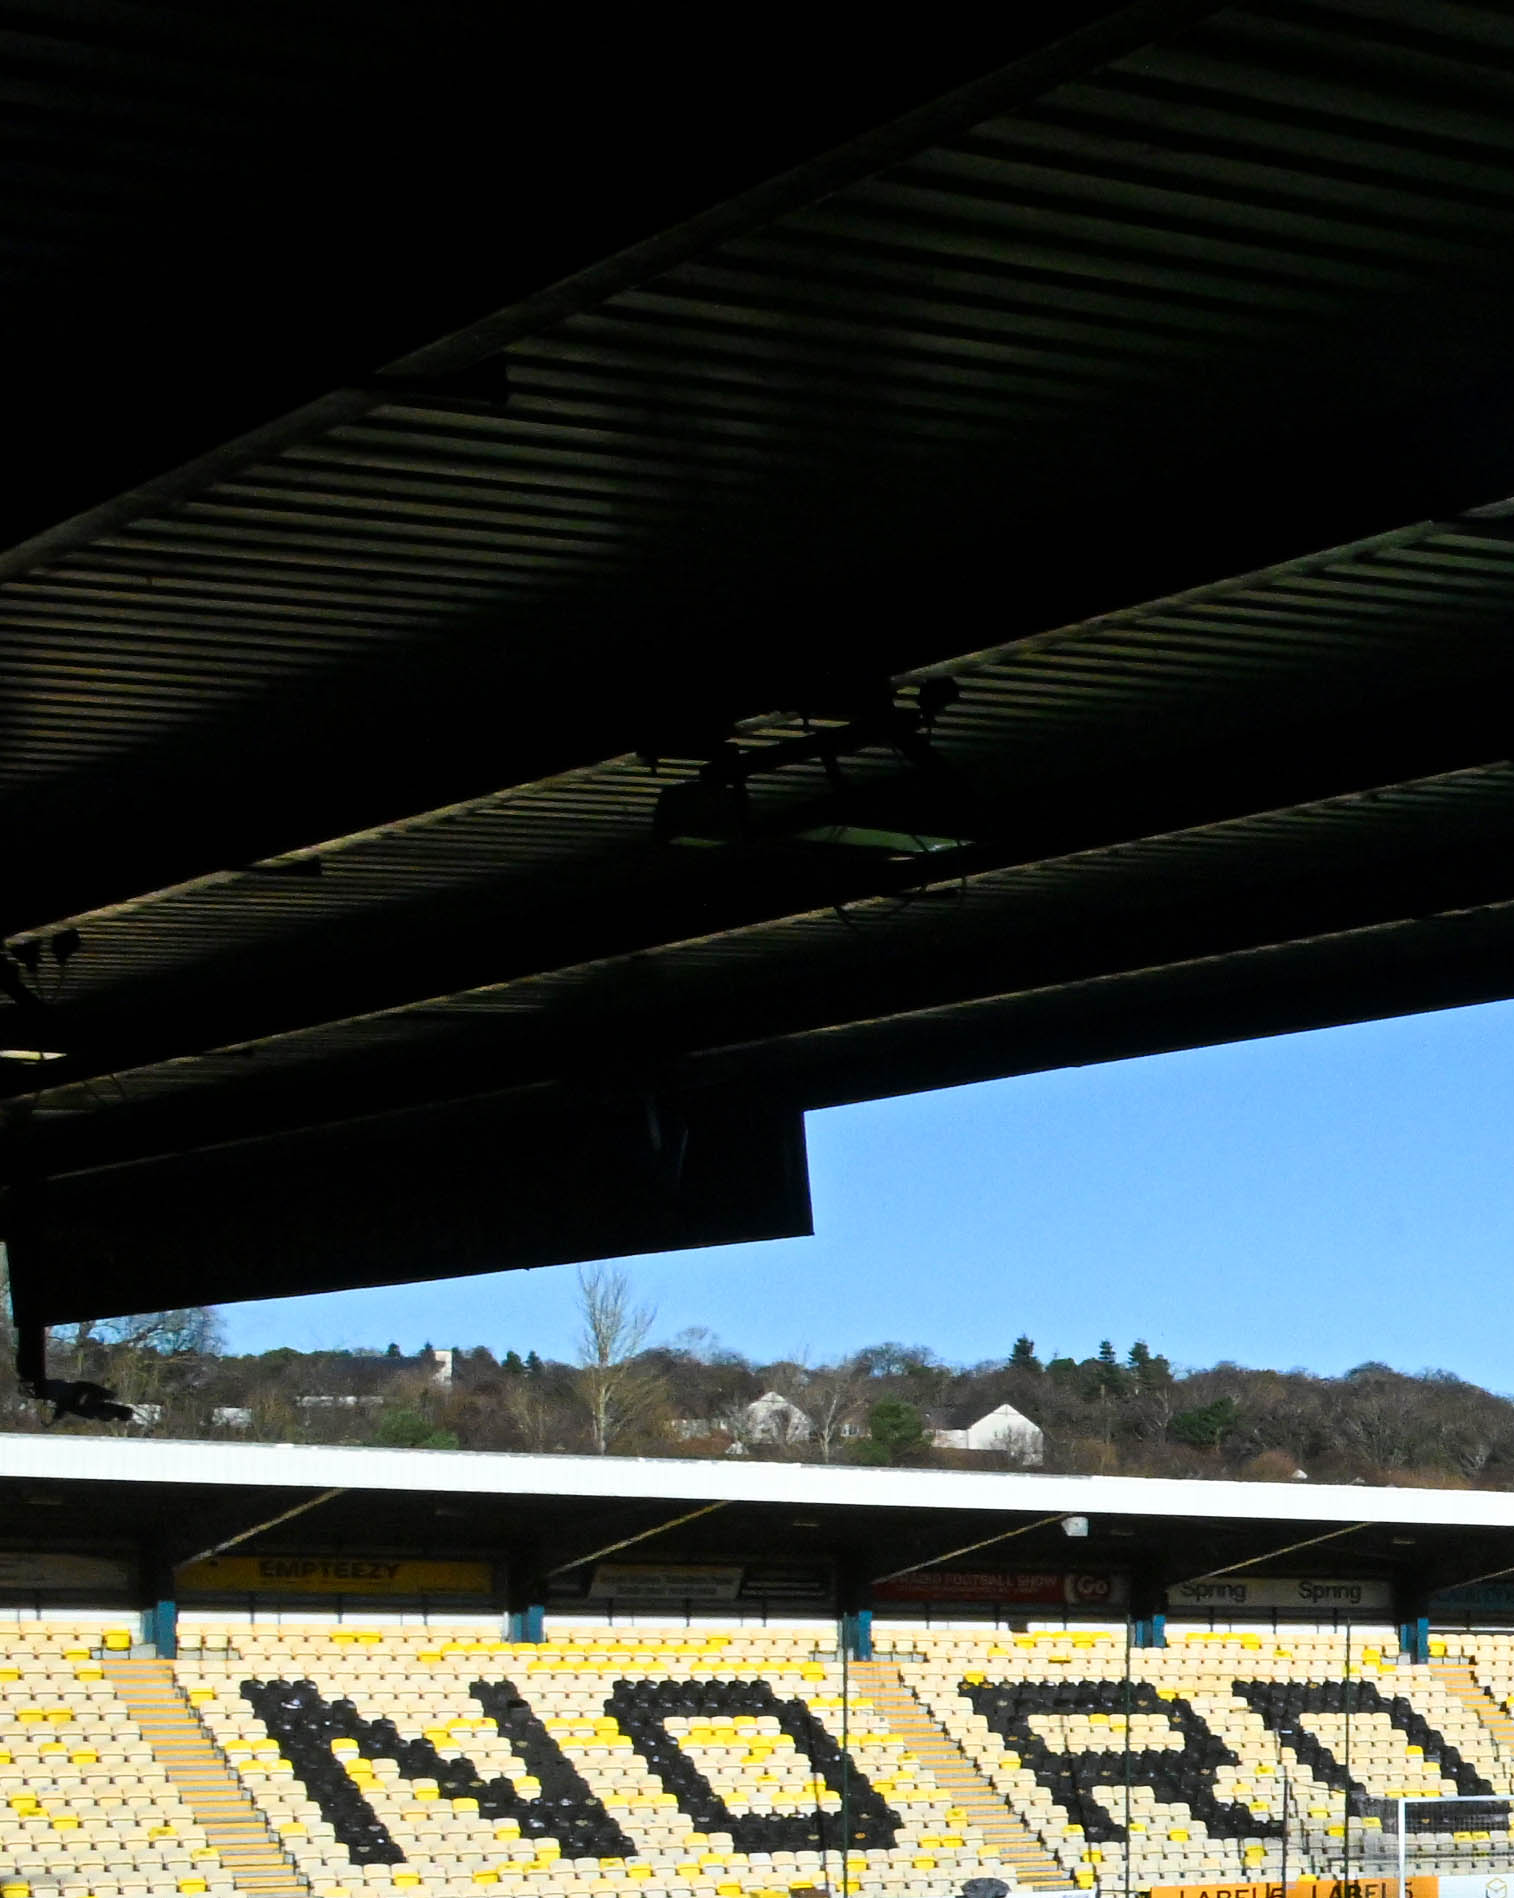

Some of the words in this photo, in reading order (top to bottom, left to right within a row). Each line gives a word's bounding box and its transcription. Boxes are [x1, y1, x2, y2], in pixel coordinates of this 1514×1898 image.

[259, 1559, 400, 1581] EMPTEEZY
[1180, 1582, 1247, 1602] Spring
[1299, 1582, 1362, 1603] Spring
